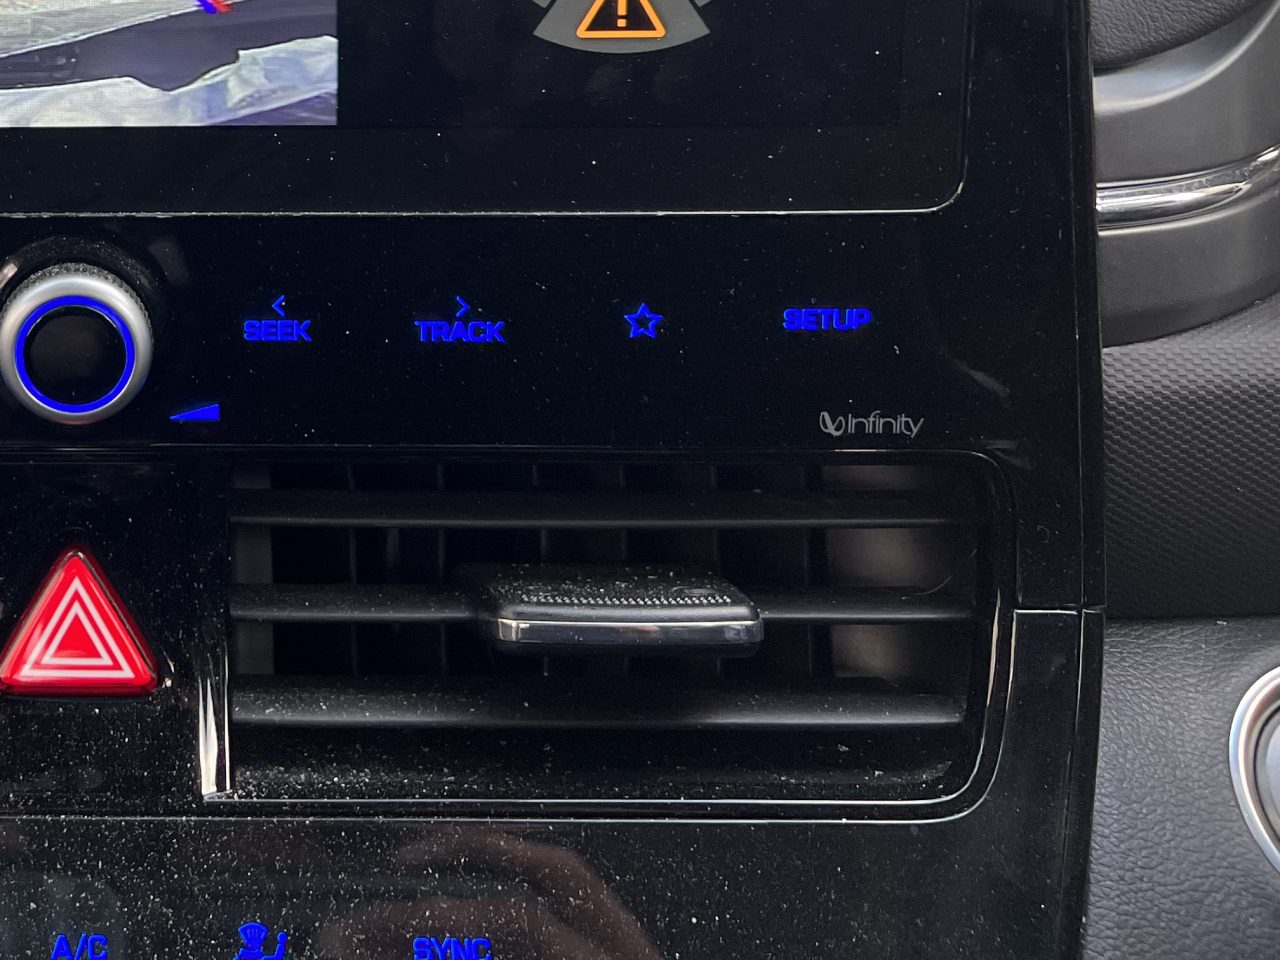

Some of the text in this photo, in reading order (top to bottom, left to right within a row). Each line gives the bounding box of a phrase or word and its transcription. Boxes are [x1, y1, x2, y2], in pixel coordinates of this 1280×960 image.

[784, 308, 871, 330] SETUP
[244, 320, 311, 342] SEEK
[416, 320, 505, 343] TRACK
[847, 410, 924, 439] Infinity
[51, 934, 107, 960] A/C
[413, 936, 492, 960] SYNC
